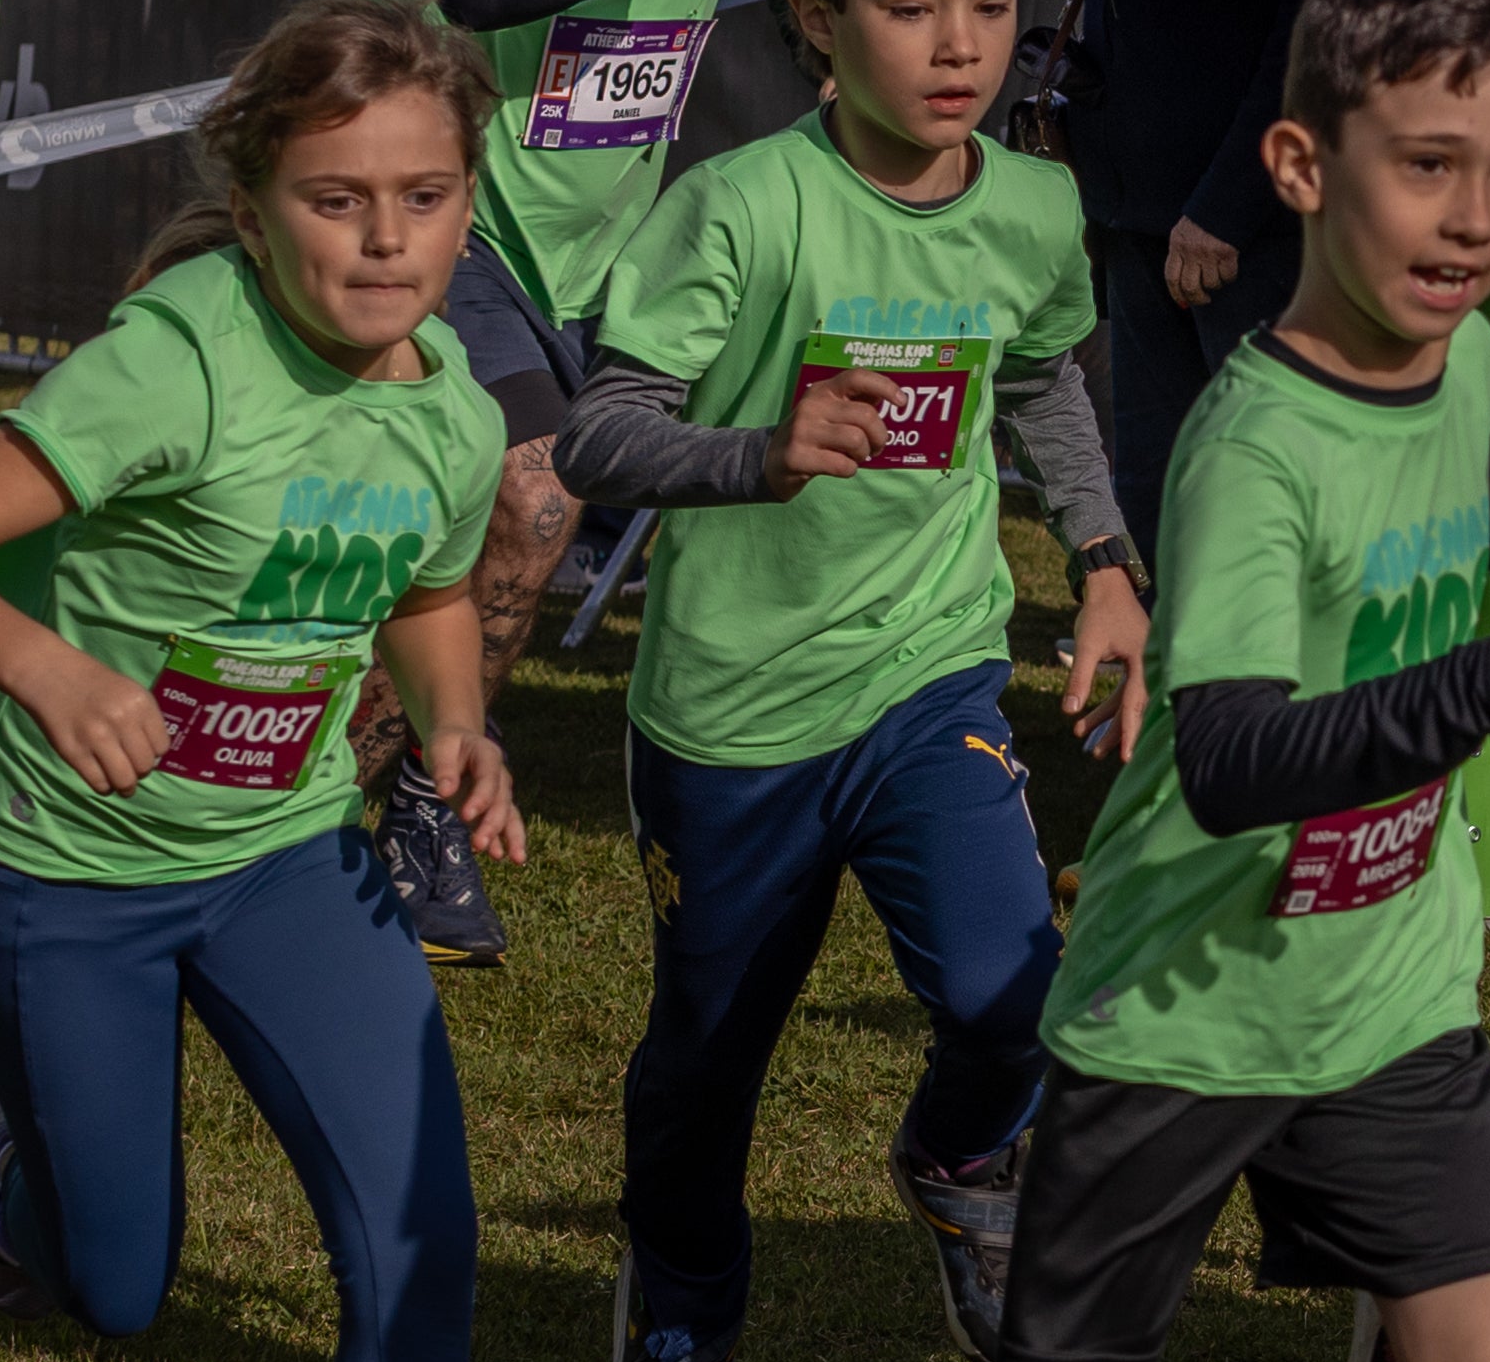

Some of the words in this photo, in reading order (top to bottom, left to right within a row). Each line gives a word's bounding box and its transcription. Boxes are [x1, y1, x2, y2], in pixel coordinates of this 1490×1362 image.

[583, 31, 636, 50] ATHENAS
[550, 60, 569, 93] E
[592, 58, 677, 102] 1965
[540, 104, 564, 118] 25K
[613, 107, 640, 119] DANIEL
[824, 296, 992, 338] ATHENAS
[844, 341, 903, 358] ATHENAS
[905, 344, 935, 358] KIDS
[852, 356, 875, 367] RUN
[876, 358, 921, 368] STRONGER
[878, 385, 956, 423] 071
[884, 430, 920, 446] OAO
[278, 475, 433, 536] ATHENAS
[237, 524, 425, 624] KIDS
[1344, 548, 1490, 688] KID
[213, 657, 276, 678] ATHENAS
[162, 687, 198, 707] 100m
[201, 700, 323, 745] 10087
[214, 746, 275, 768] OLIVIA
[1347, 786, 1444, 864] 10084
[1356, 848, 1415, 887] MIGUEL
